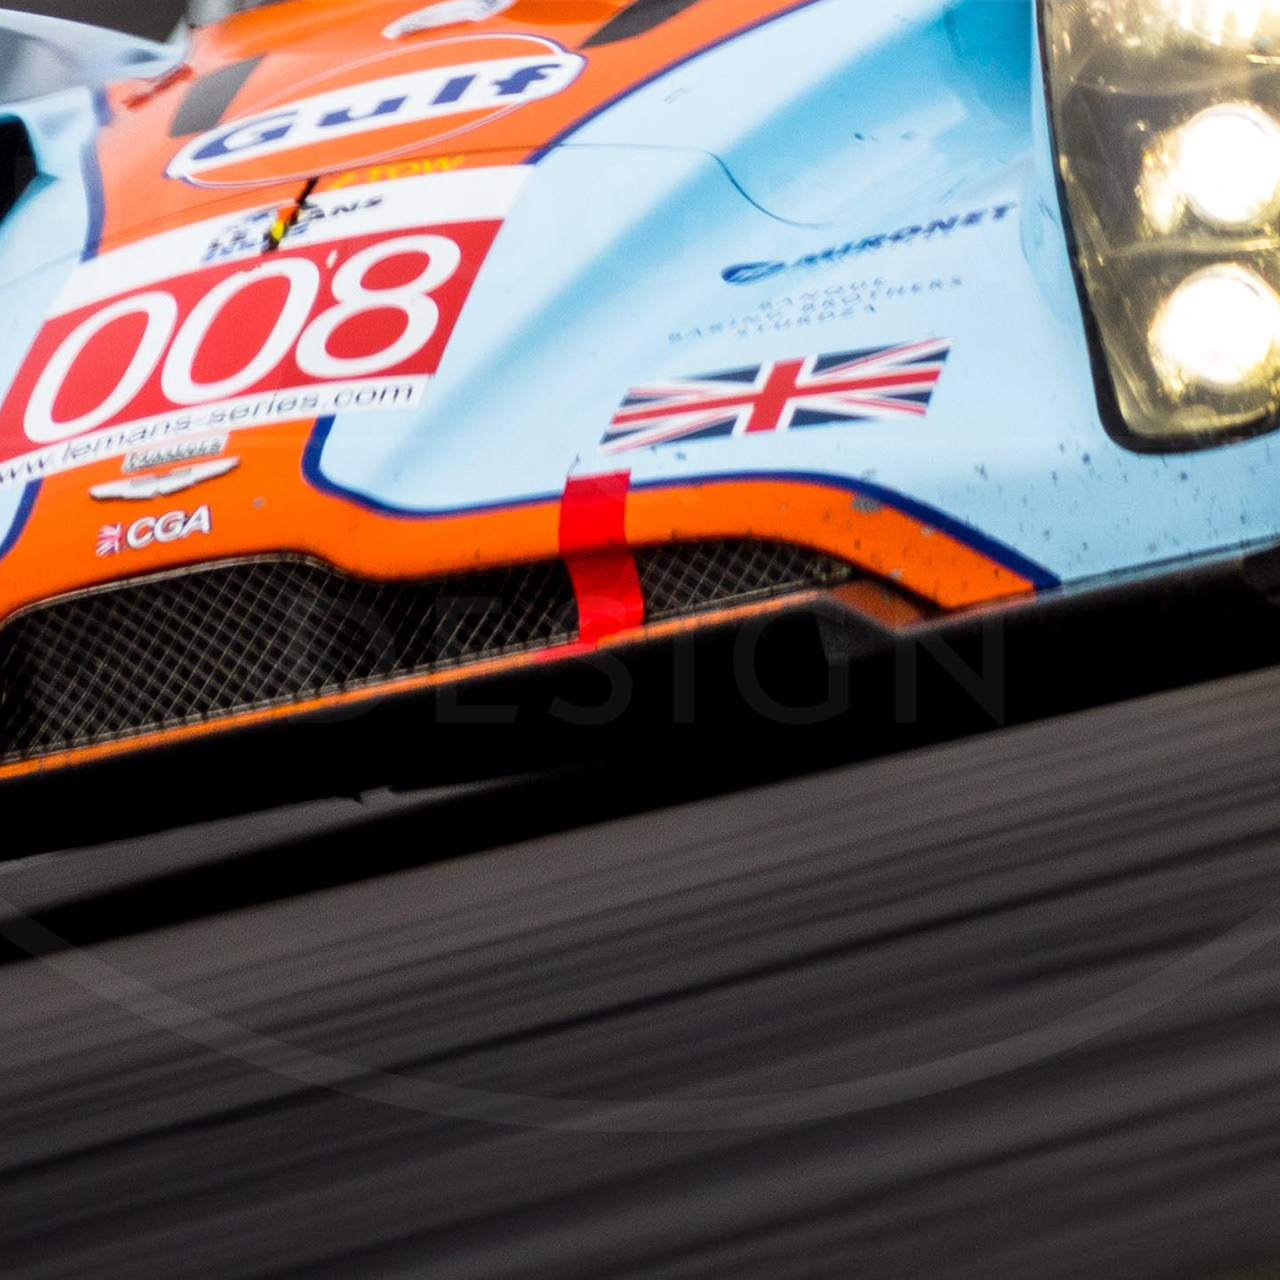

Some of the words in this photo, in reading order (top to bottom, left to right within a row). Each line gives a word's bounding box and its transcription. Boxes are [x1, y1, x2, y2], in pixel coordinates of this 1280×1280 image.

[188, 60, 565, 162] Gulf
[23, 233, 462, 445] 008
[126, 504, 212, 549] CGA
